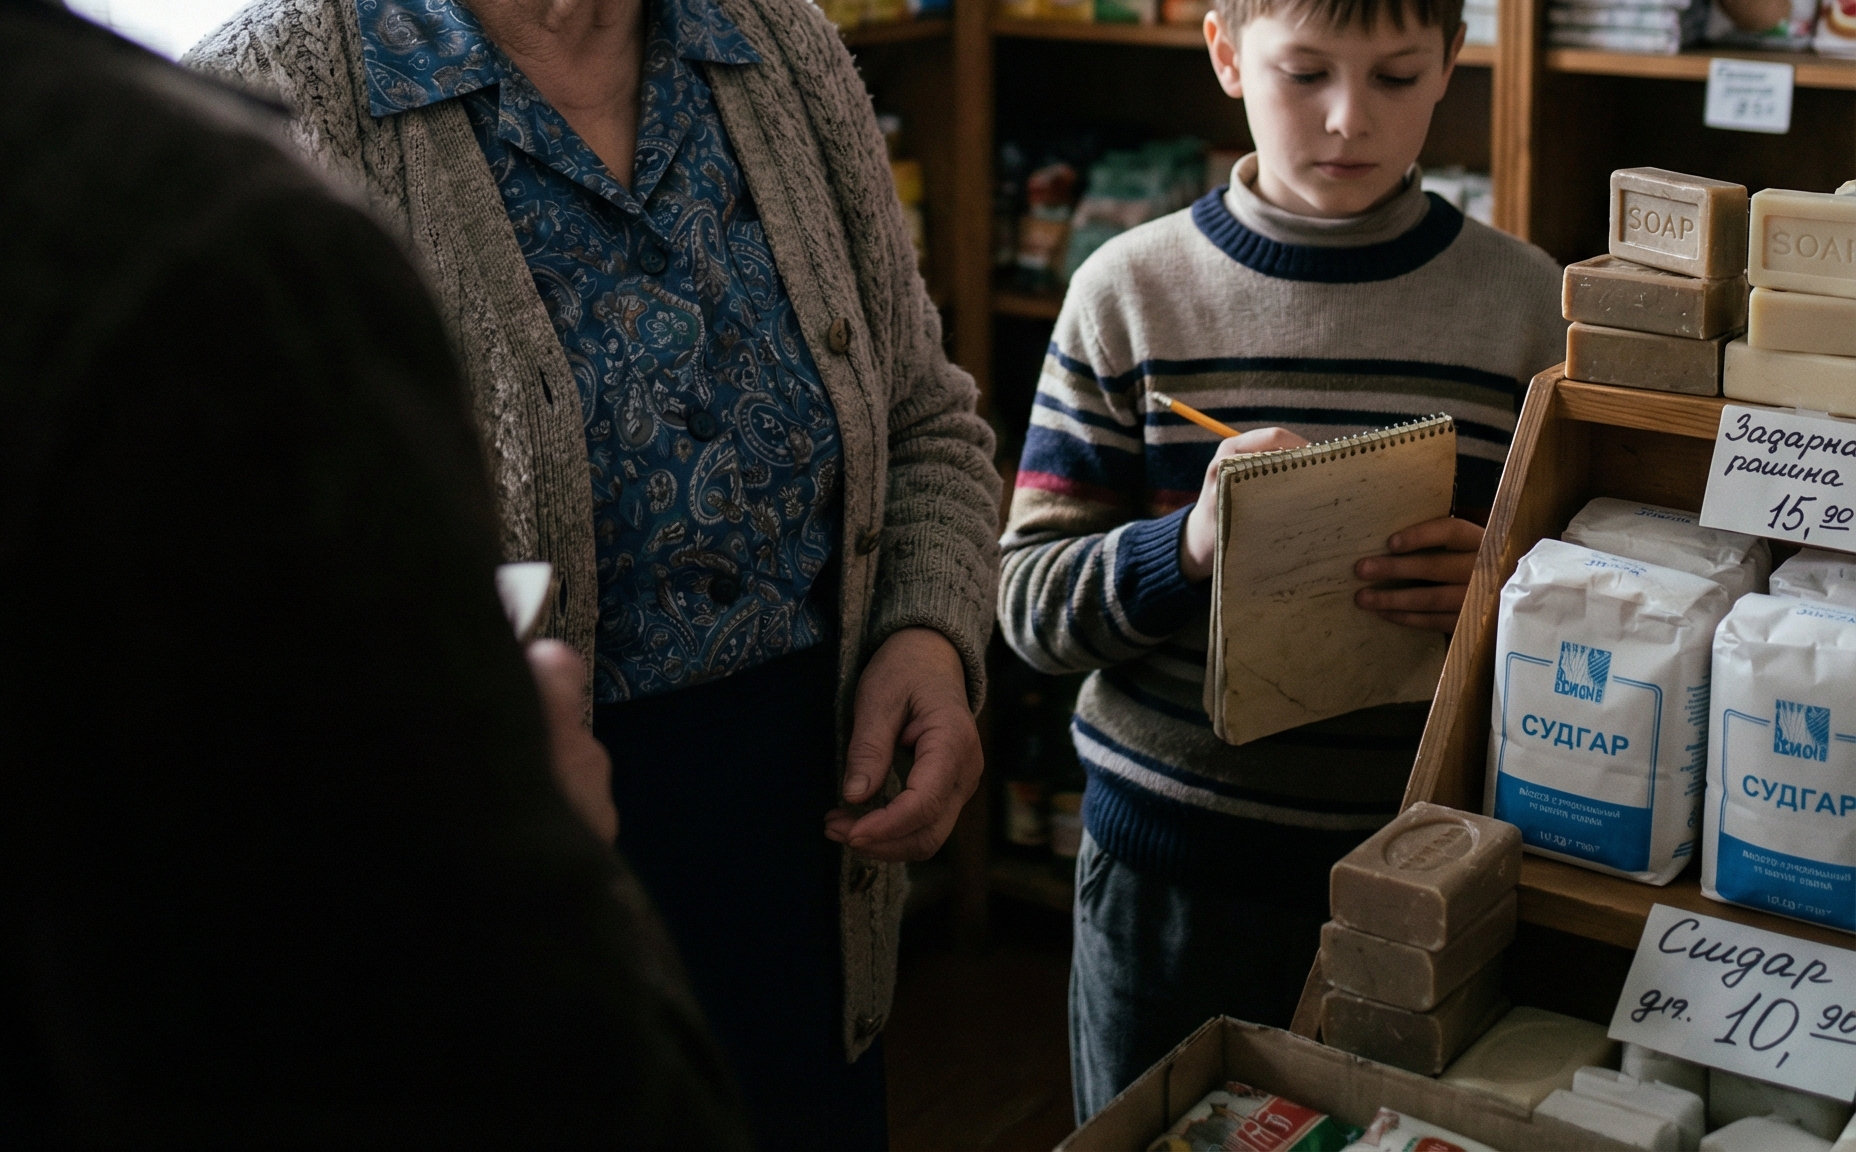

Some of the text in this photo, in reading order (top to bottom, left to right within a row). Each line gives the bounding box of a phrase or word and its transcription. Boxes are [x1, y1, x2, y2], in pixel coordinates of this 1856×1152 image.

[1628, 206, 1694, 241] SOAP
[1521, 713, 1629, 757] СУДГАР
[1742, 774, 1856, 817] СУДГАР
